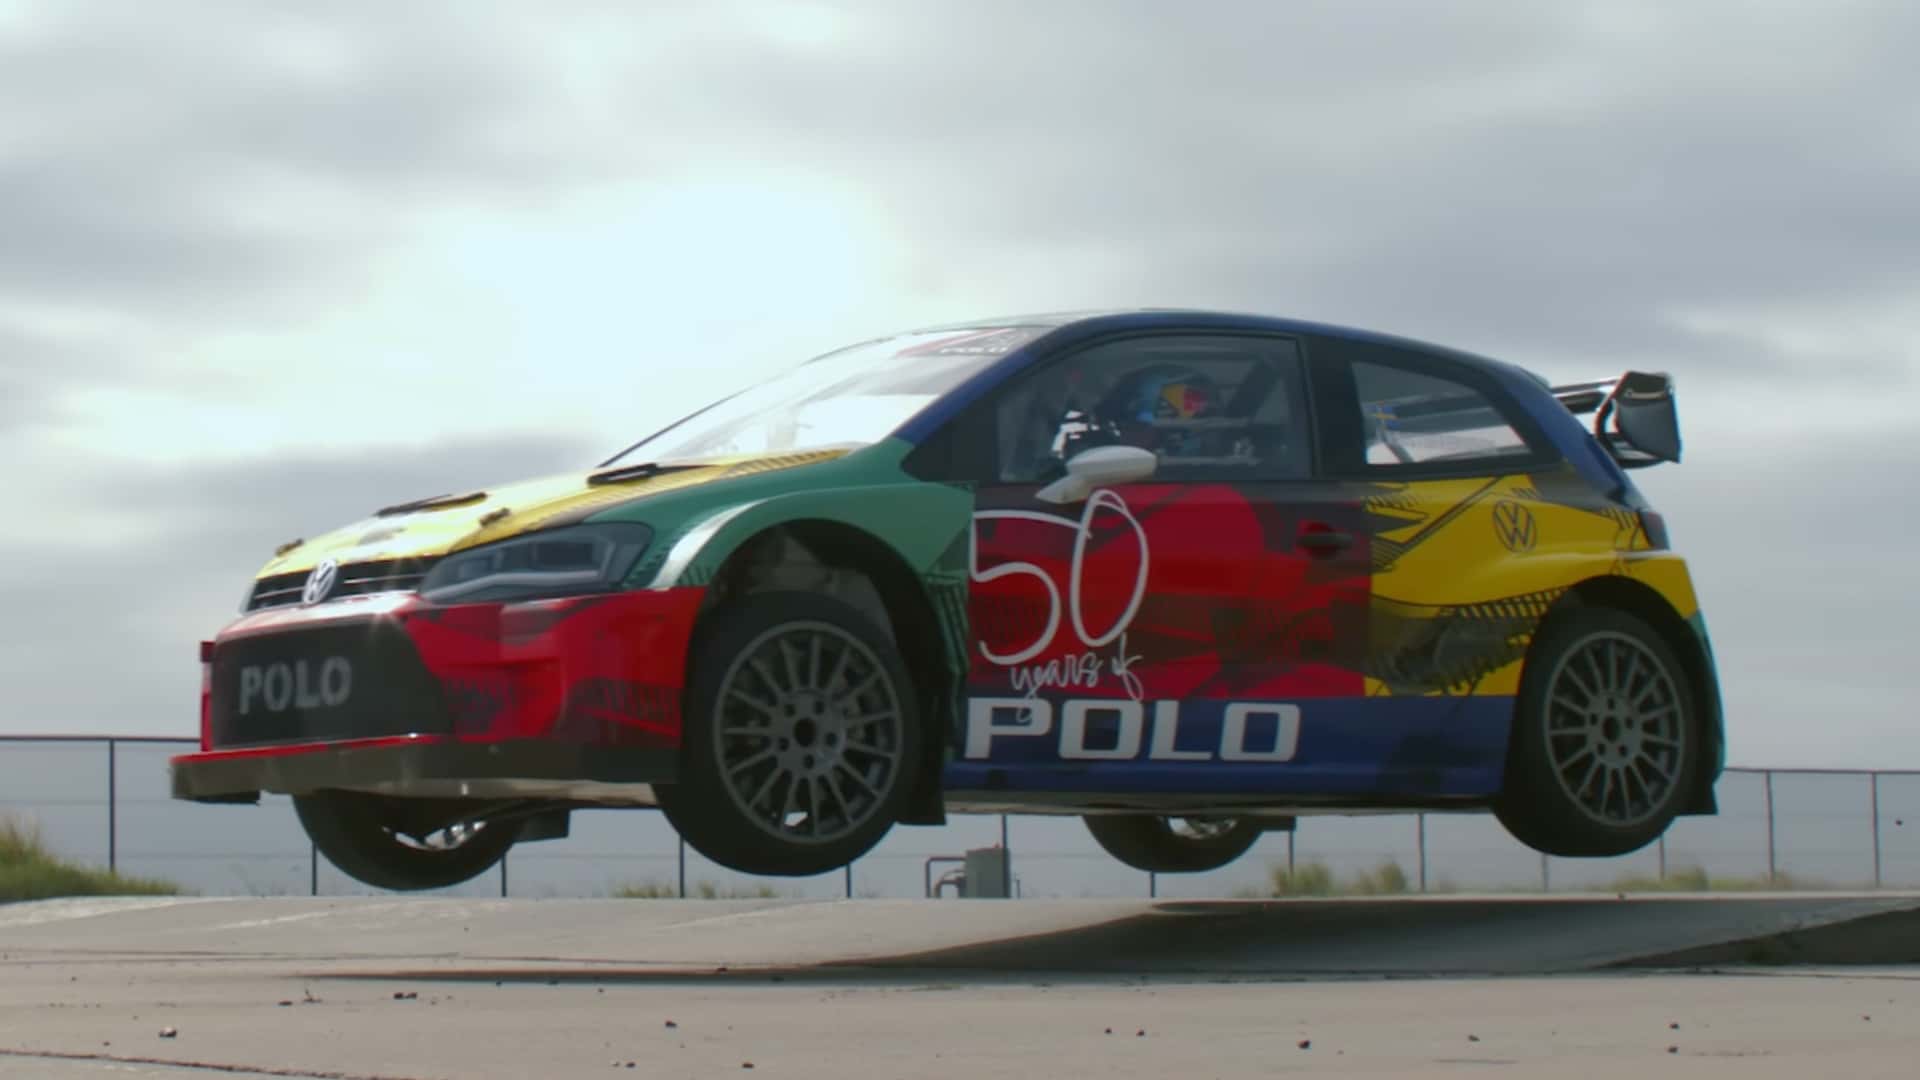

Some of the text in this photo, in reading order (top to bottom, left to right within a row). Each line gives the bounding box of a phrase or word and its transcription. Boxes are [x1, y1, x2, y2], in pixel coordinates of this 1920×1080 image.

[970, 489, 1149, 665] 50
[239, 656, 352, 714] POLO
[1010, 632, 1143, 722] years of
[965, 697, 1300, 761] POLO
